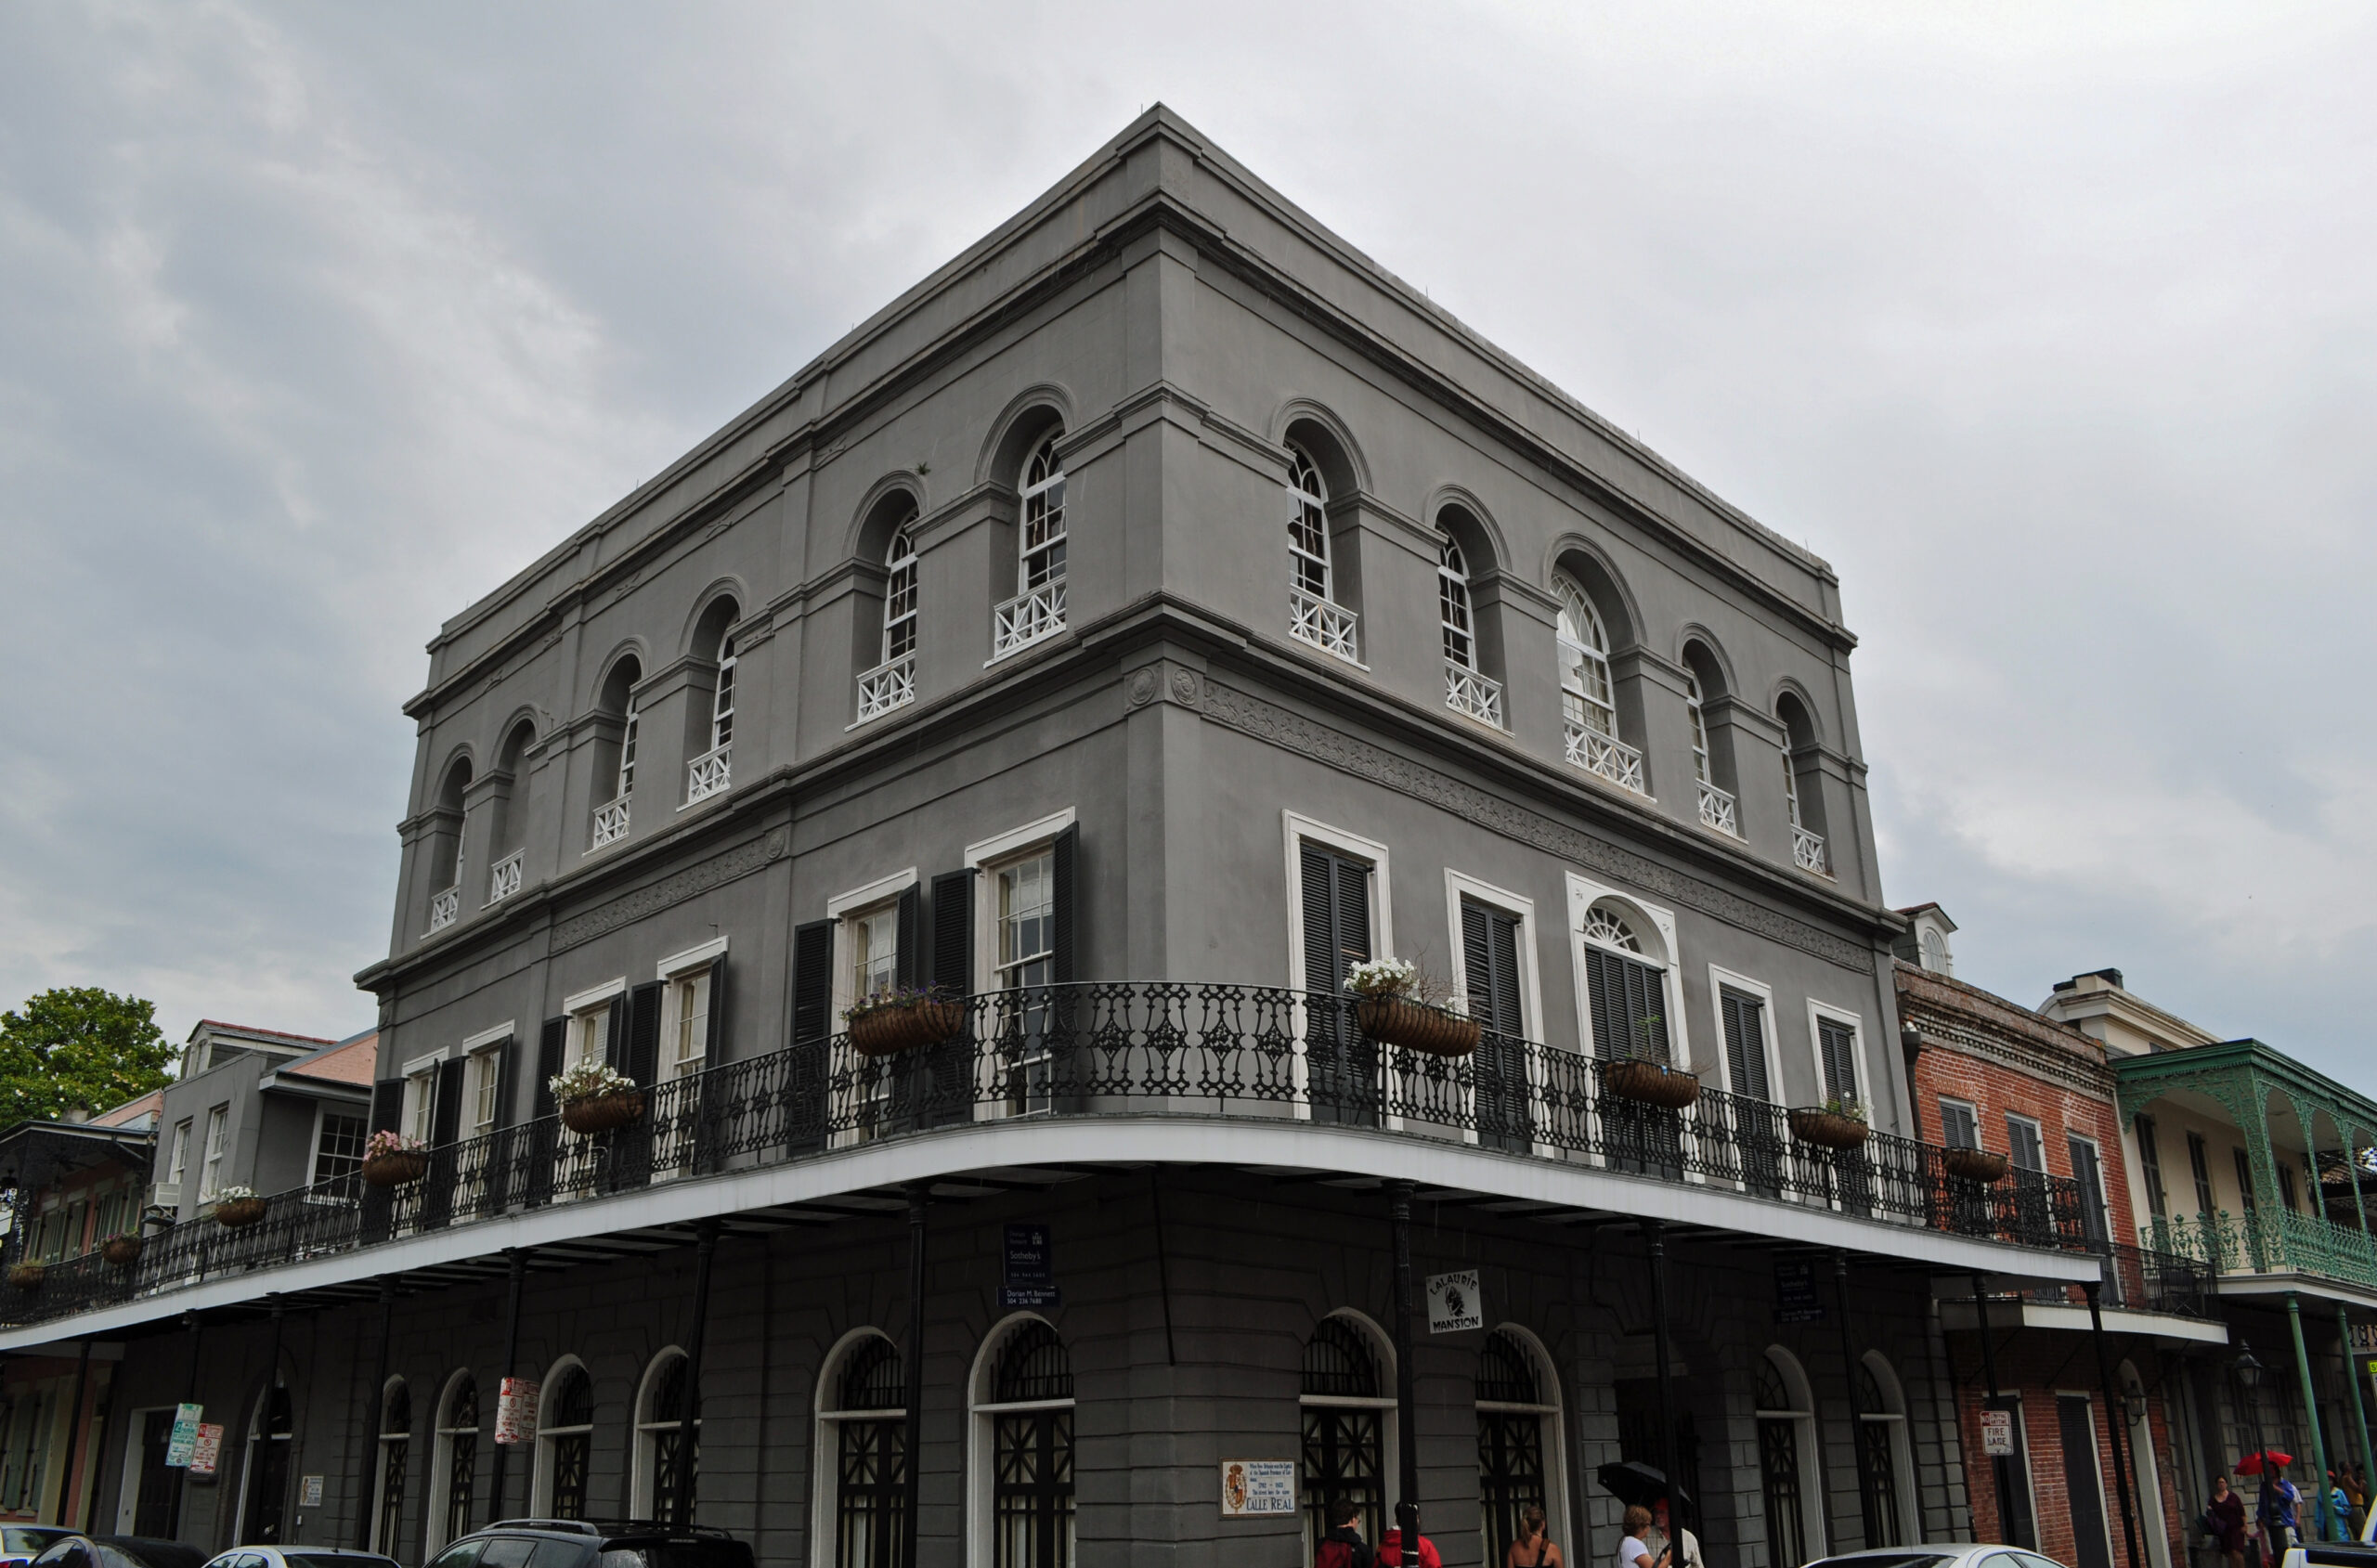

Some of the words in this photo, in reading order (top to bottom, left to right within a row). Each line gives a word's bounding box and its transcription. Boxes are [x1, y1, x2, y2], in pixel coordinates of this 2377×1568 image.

[1010, 1251, 1041, 1262] Sotheby's
[1430, 1274, 1478, 1295] LALAURIE
[1007, 1289, 1025, 1298] Dorian
[1033, 1289, 1056, 1298] Bennett
[1433, 1316, 1479, 1331] MANSION
[1987, 1428, 2005, 1437] FIRE
[1246, 1497, 1267, 1510] CALLE
[1271, 1497, 1293, 1510] REAL
